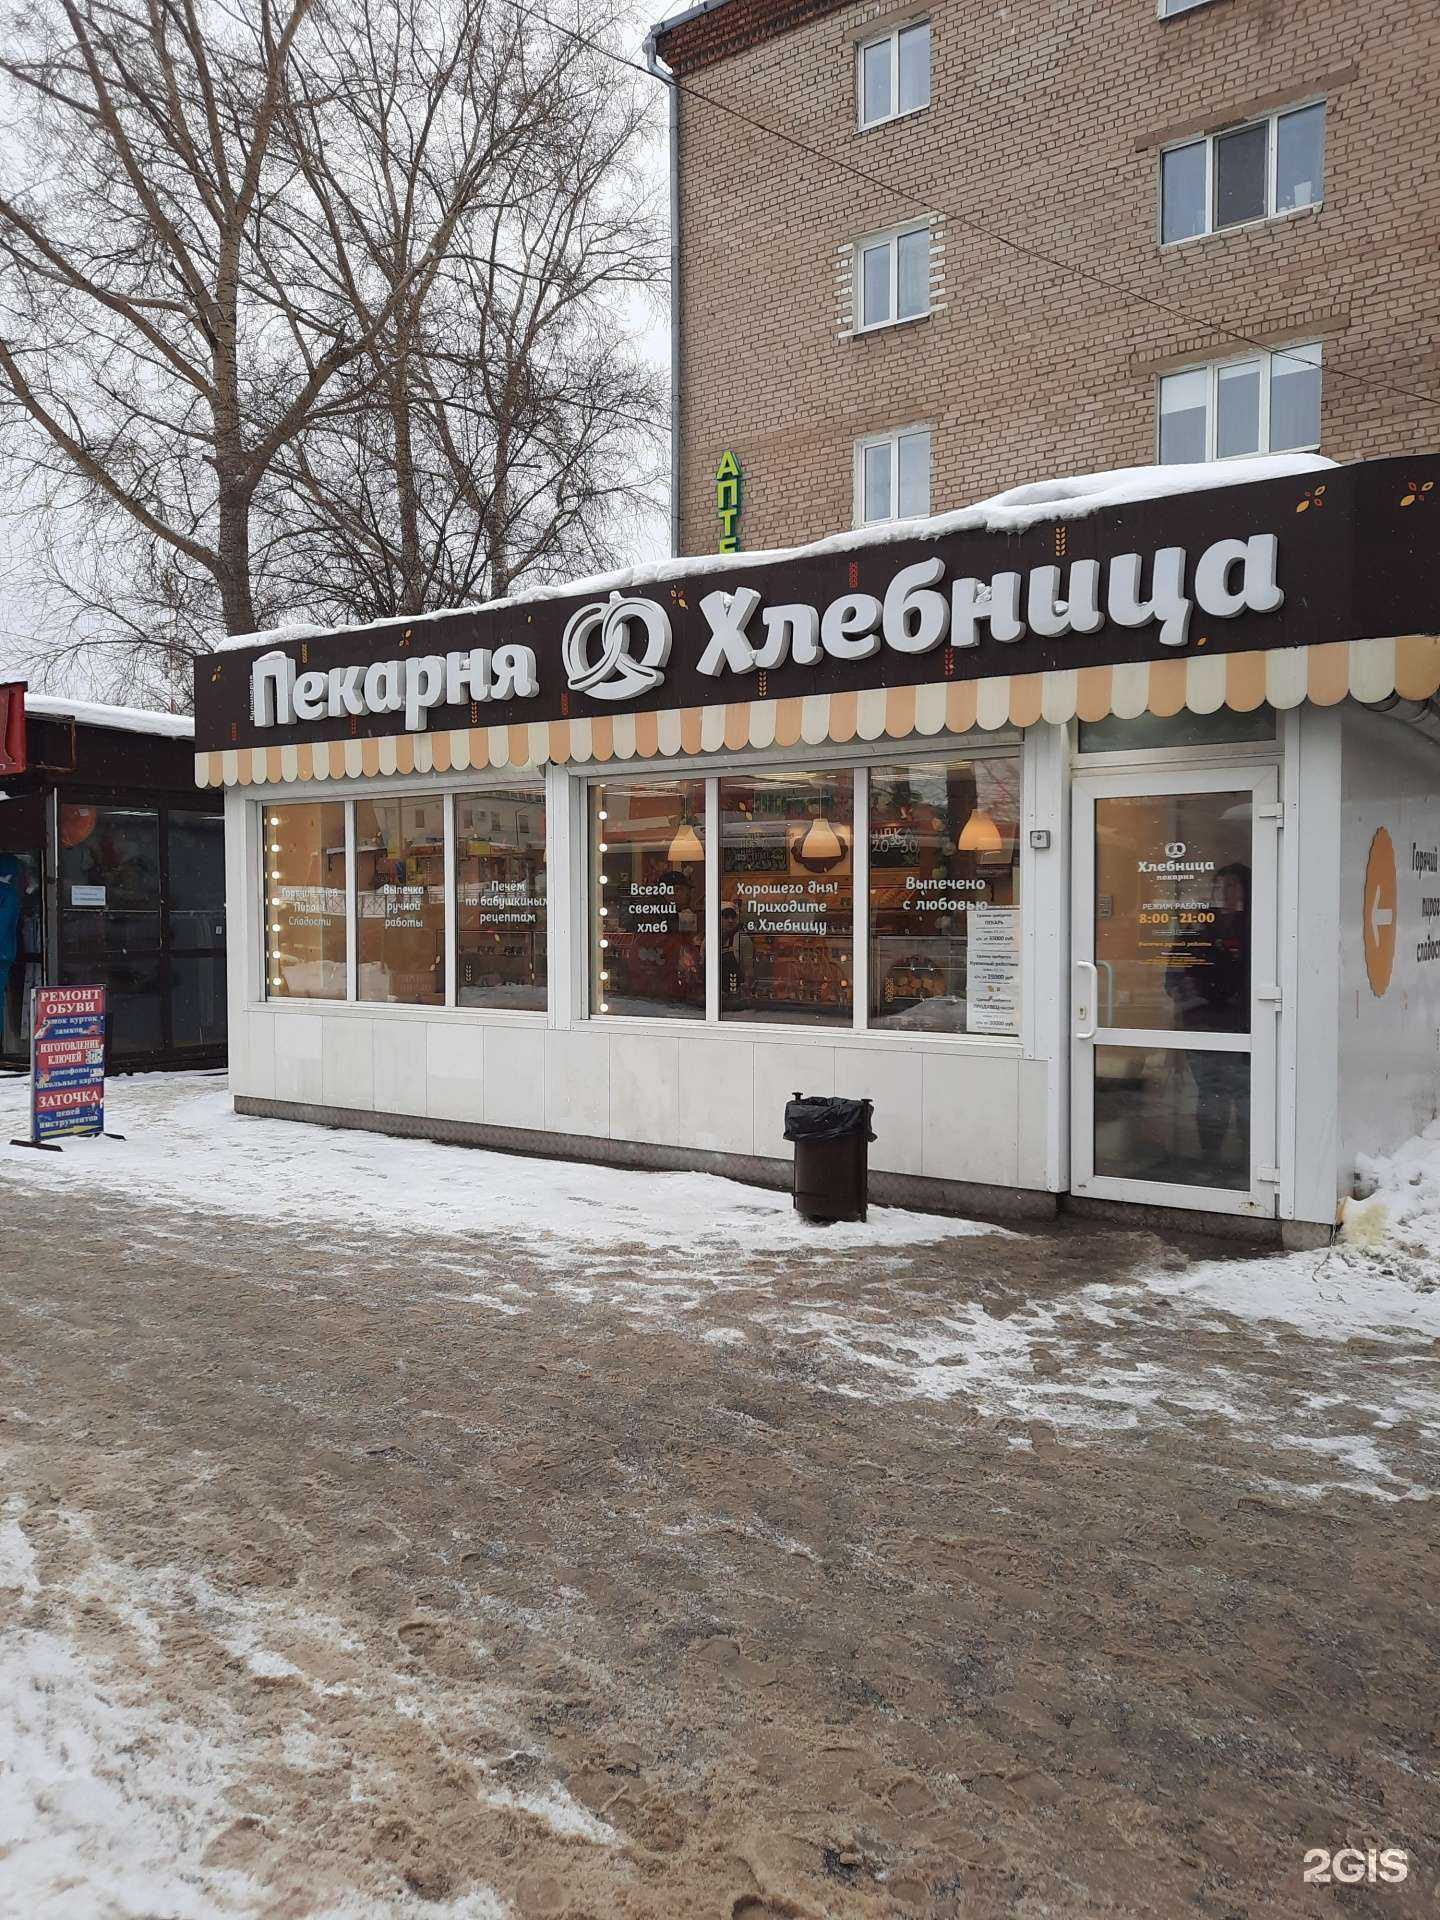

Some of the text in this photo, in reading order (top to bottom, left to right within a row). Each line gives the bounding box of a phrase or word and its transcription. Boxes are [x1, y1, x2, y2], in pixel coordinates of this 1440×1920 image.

[250, 533, 1285, 731] Пекарня Хлебница
[1138, 861, 1215, 873] Хлебница
[1412, 842, 1438, 880] Горячий
[384, 884, 424, 896] Выпечка
[491, 880, 525, 893] Печём
[630, 882, 674, 897] Всегда
[736, 880, 838, 896] Хорошего дня!
[905, 875, 986, 892] Выпечено
[386, 897, 421, 913] ручной
[465, 899, 478, 907] по
[628, 900, 677, 915] свежий
[747, 900, 827, 914] Приходите
[903, 896, 989, 912] с любовью
[1175, 902, 1210, 910] РАБОТЫ
[288, 915, 332, 928] Сладости
[385, 917, 423, 930] работы
[480, 913, 536, 926] рецептам
[1139, 914, 1169, 924] 8:00
[1180, 913, 1215, 923] 21:00
[637, 920, 668, 934] хлеб
[748, 919, 828, 936] в Хлебницу
[40, 989, 101, 1003] РЕМОНТ
[46, 1001, 95, 1015] ОБУВИ
[40, 1039, 101, 1053] ИЗГОТОВЛЕНИЕ
[48, 1054, 82, 1065] КЛЮЧЕЙ
[38, 1091, 99, 1108] ЗАТОЧКА
